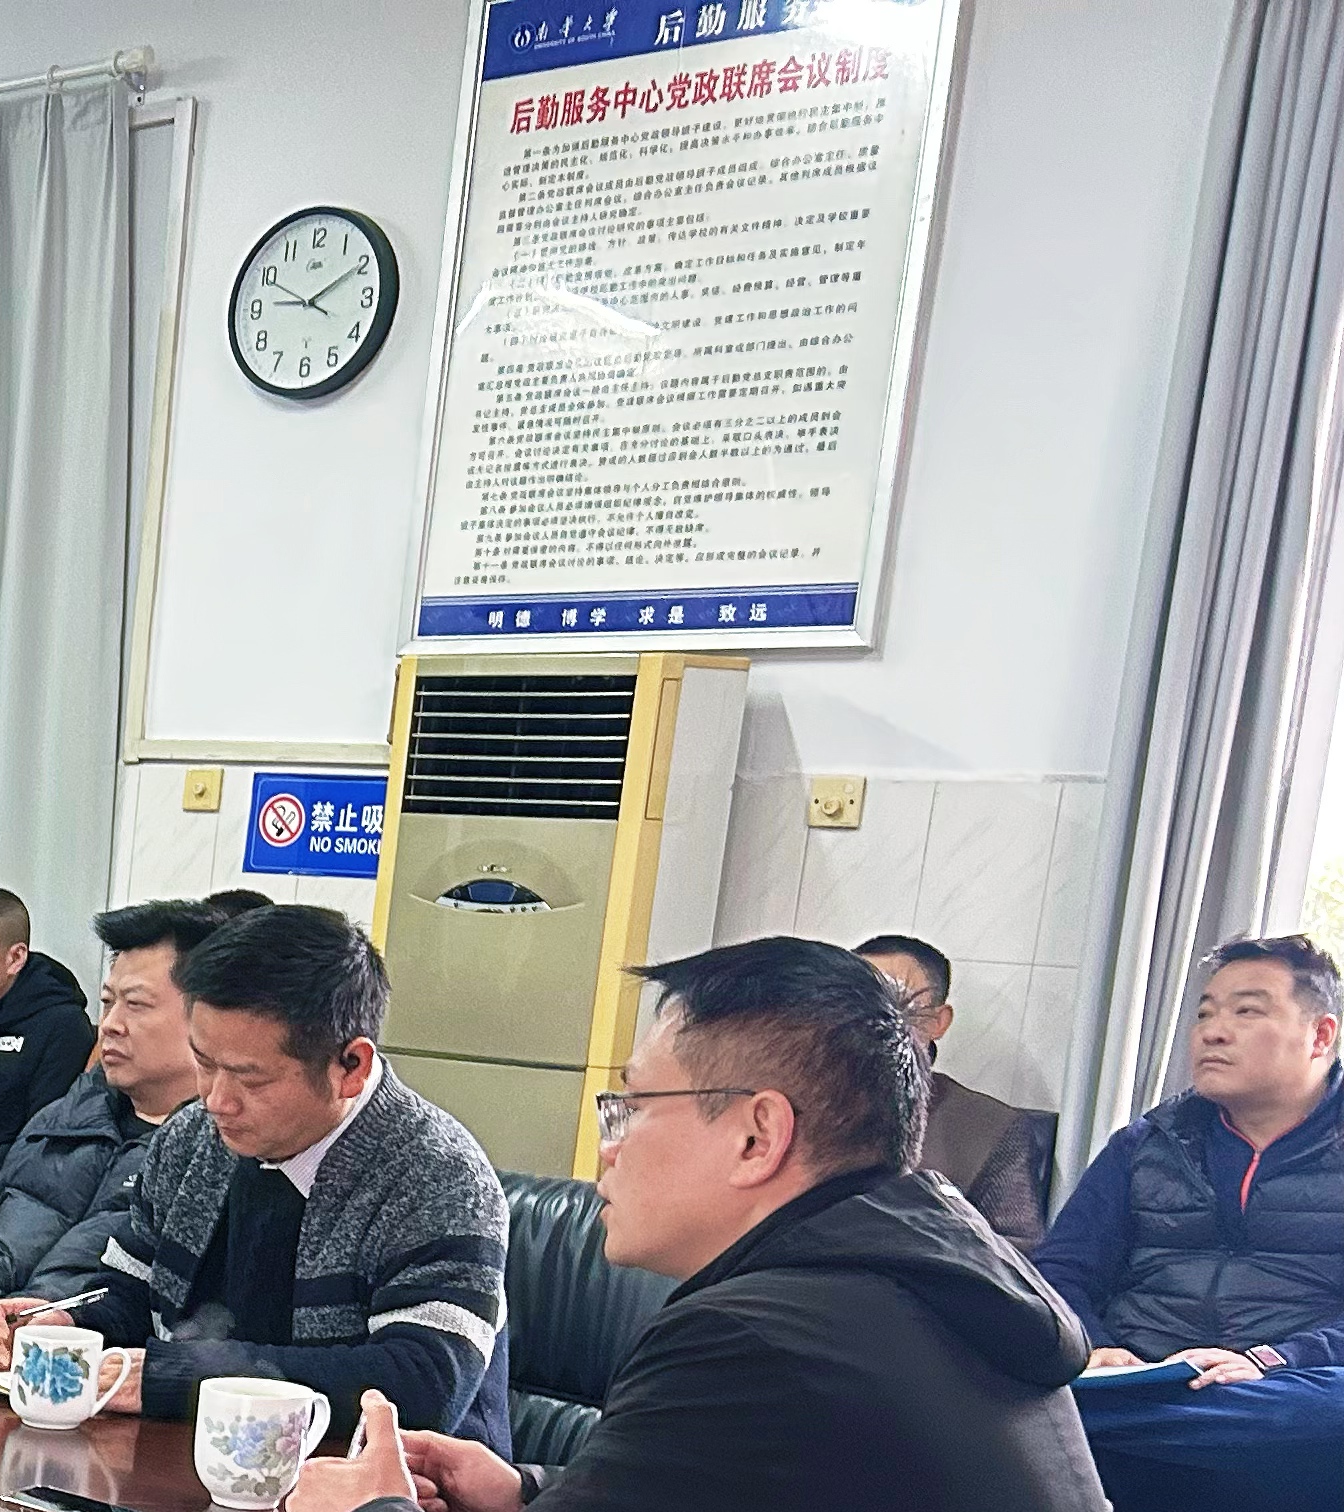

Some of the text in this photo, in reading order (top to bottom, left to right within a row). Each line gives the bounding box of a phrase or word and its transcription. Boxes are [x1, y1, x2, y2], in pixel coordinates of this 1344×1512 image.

[510, 46, 892, 135] 后勤服务中心党政联席会议制度
[312, 227, 327, 249] 12
[342, 233, 349, 256] 1
[284, 239, 297, 263] 11
[261, 265, 278, 287] 10
[357, 254, 370, 275] 2
[360, 286, 374, 309] 3
[250, 298, 263, 321] 9
[255, 329, 268, 352] 8
[347, 321, 361, 343] 4
[272, 350, 284, 373] 7
[298, 356, 311, 378] 6
[326, 346, 339, 368] 5
[488, 602, 769, 629] 明德 博学 求是 致远
[309, 836, 332, 853] NO
